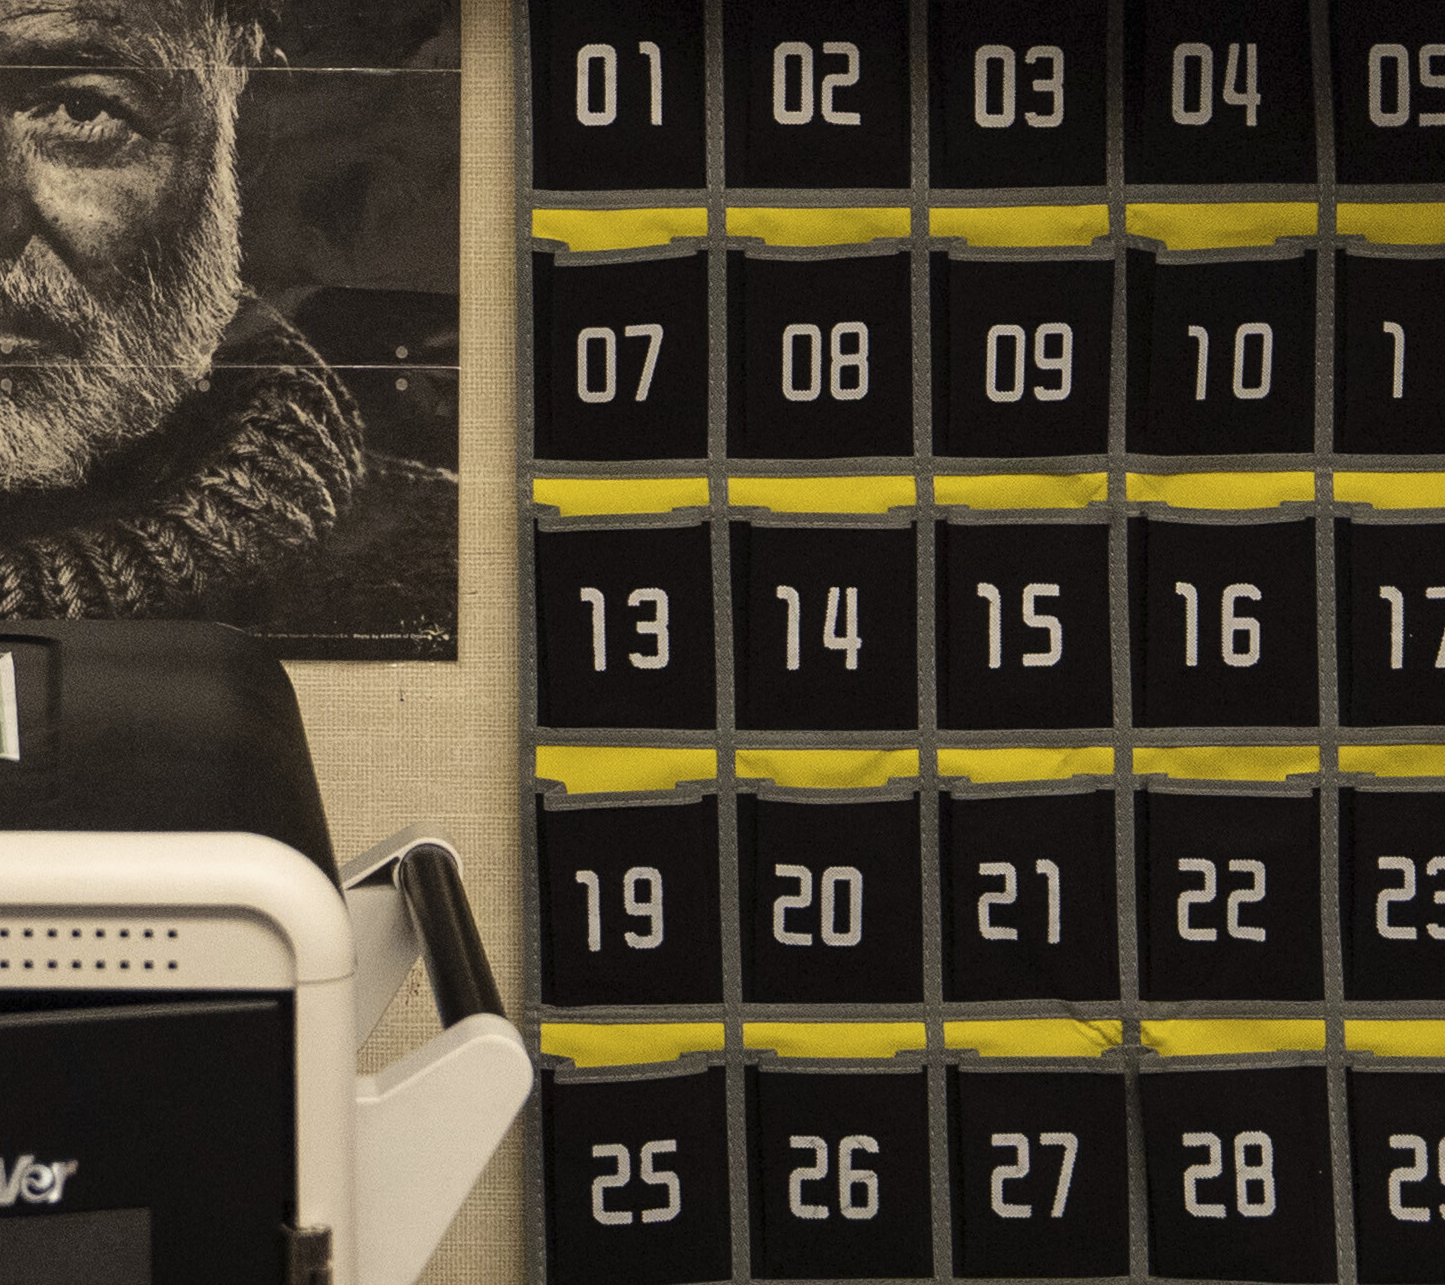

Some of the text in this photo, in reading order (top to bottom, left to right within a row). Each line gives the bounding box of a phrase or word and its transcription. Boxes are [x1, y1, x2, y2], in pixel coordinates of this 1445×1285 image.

[576, 41, 663, 127] 01
[773, 41, 861, 126] 02
[974, 45, 1064, 128] 03
[1172, 43, 1261, 126] 04
[580, 586, 670, 672] 13
[776, 585, 863, 671] 14
[977, 582, 1063, 670] 15
[1175, 581, 1263, 668] 16
